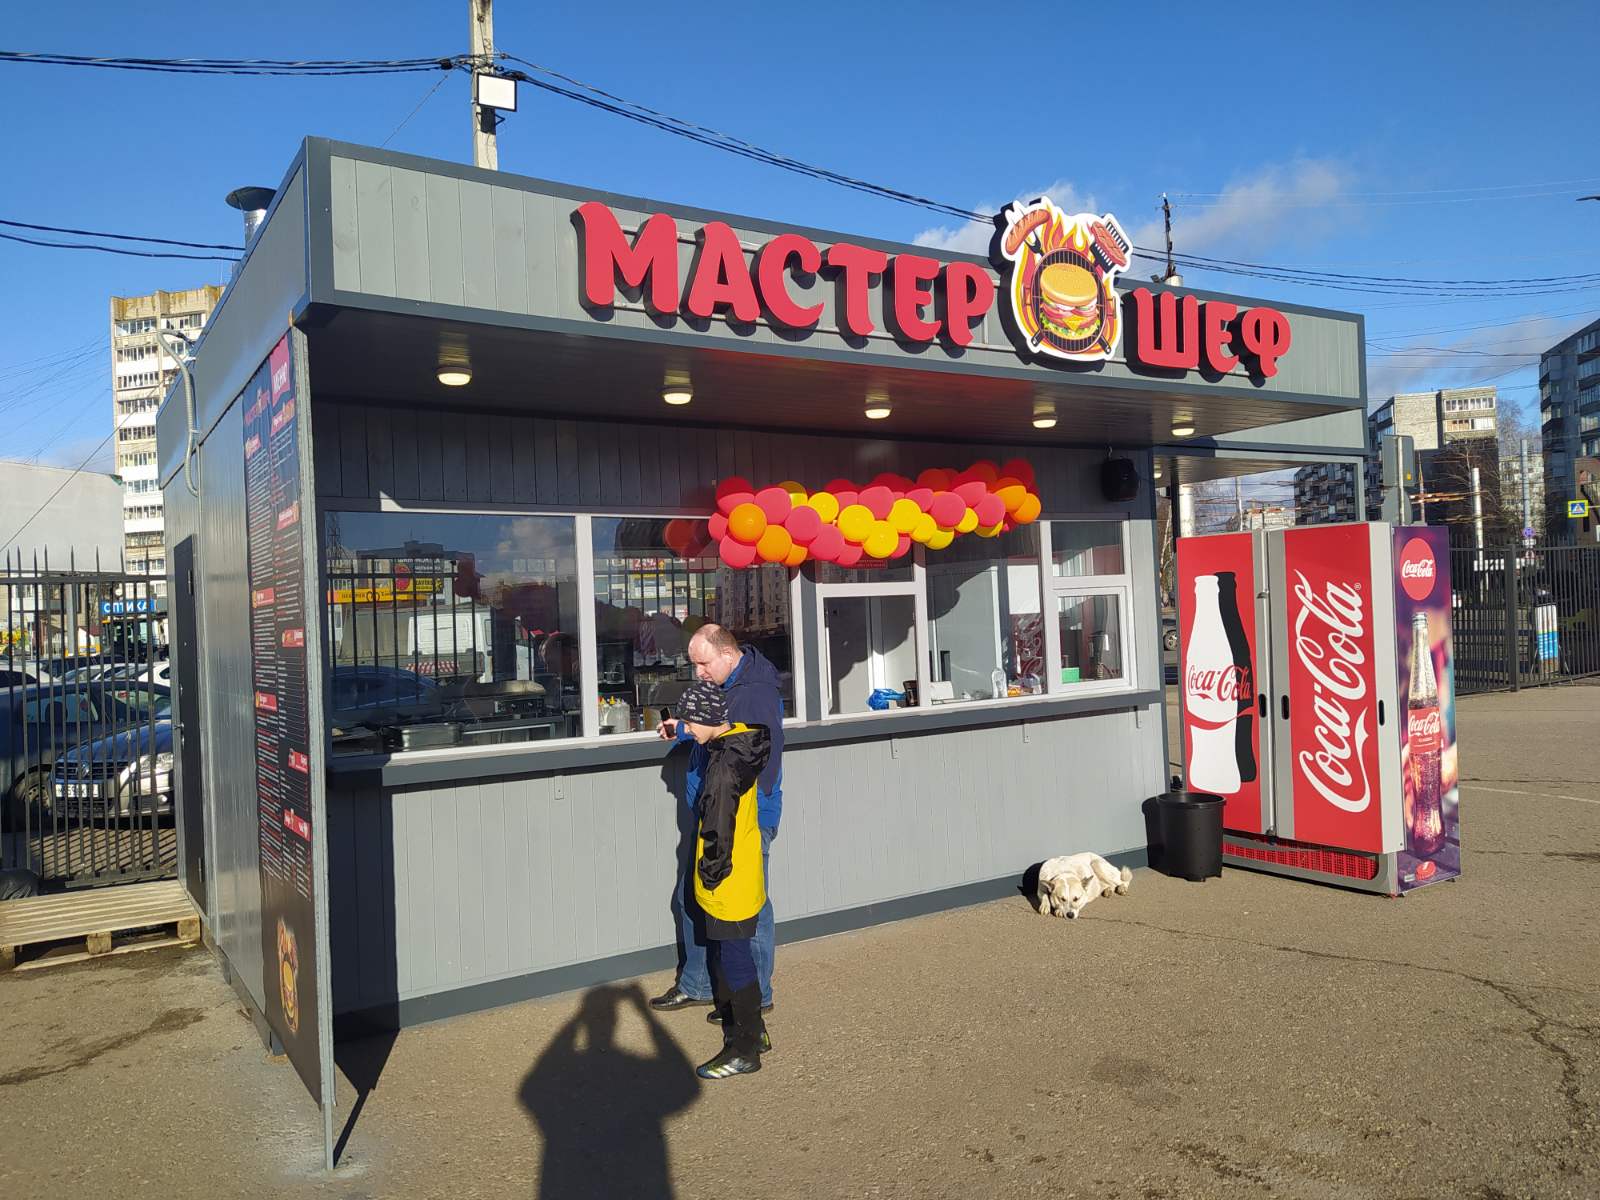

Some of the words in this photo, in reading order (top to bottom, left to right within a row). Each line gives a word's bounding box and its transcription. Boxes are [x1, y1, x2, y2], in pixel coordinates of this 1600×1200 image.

[576, 201, 994, 346] МАСТЕР
[1132, 287, 1292, 378] ШЕФ
[1401, 558, 1434, 579] Coca-Cola
[1187, 664, 1251, 703] Coca-Cola
[1293, 568, 1371, 813] Coca-Cola
